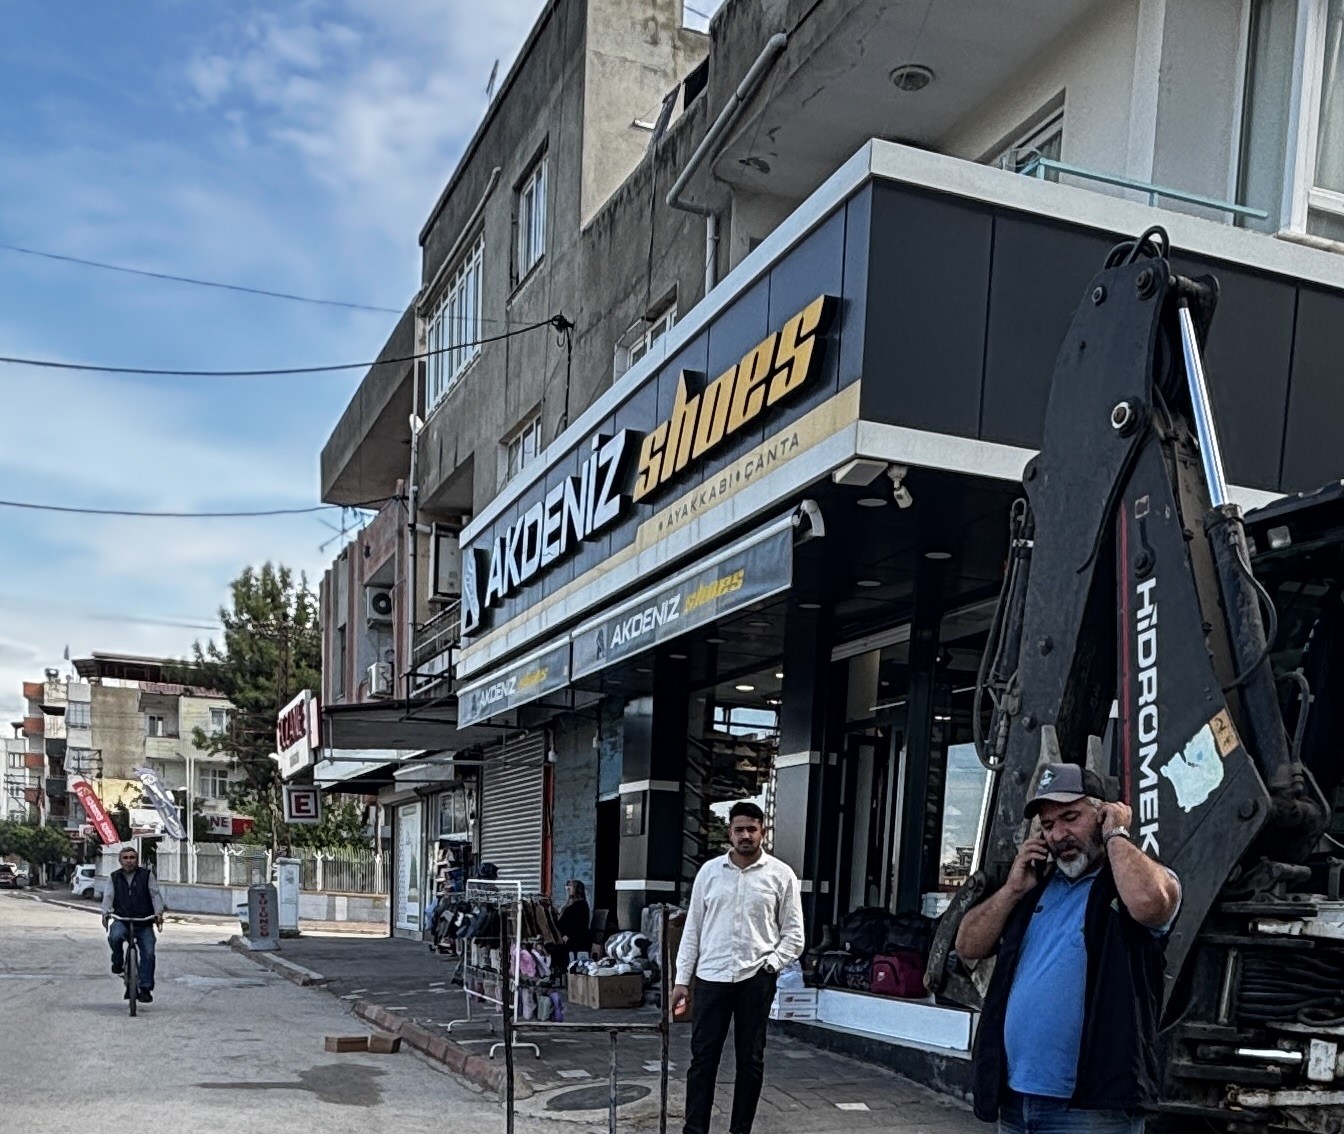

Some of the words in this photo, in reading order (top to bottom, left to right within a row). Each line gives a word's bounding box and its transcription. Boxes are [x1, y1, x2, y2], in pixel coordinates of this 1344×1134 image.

[632, 294, 826, 503] shoes
[666, 473, 733, 528] AYAKKABI
[744, 432, 799, 481] ÇANTA
[295, 794, 311, 814] E
